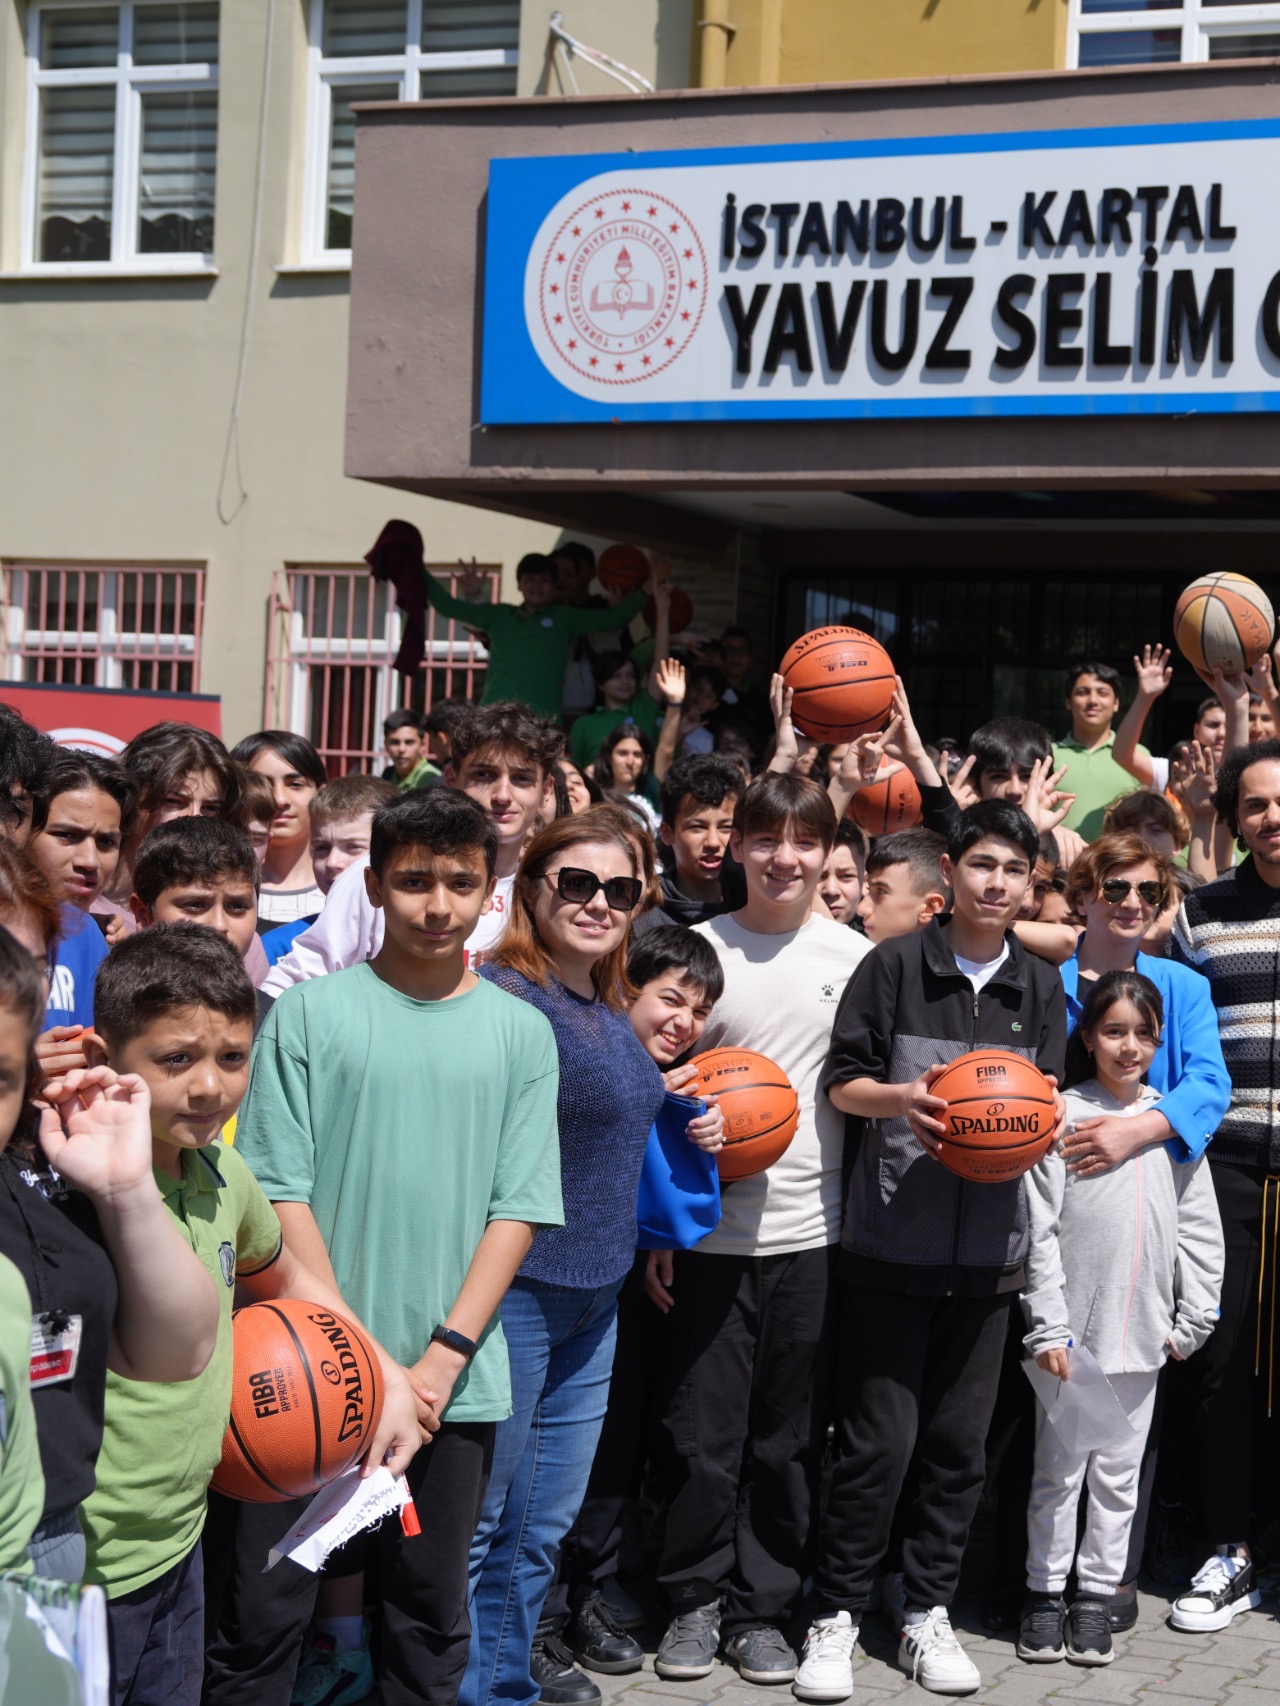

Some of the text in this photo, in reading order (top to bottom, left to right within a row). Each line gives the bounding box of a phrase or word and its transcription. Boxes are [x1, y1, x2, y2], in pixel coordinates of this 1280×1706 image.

[721, 193, 977, 260] İSTANBUL
[1022, 183, 1237, 248] KARTAL
[571, 224, 676, 348] TÜRKİYE CUMHURİYETİ MİLLİ EĞİTİM BAKANLIĞI
[723, 275, 975, 375] YAVUZ
[994, 245, 1236, 369] SELİM
[976, 1065, 1007, 1078] FIBA
[949, 1112, 1039, 1137] SPALDING
[249, 1369, 279, 1419] FIBA
[273, 1367, 291, 1412] APPROVED
[307, 1313, 364, 1443] SPALDING
